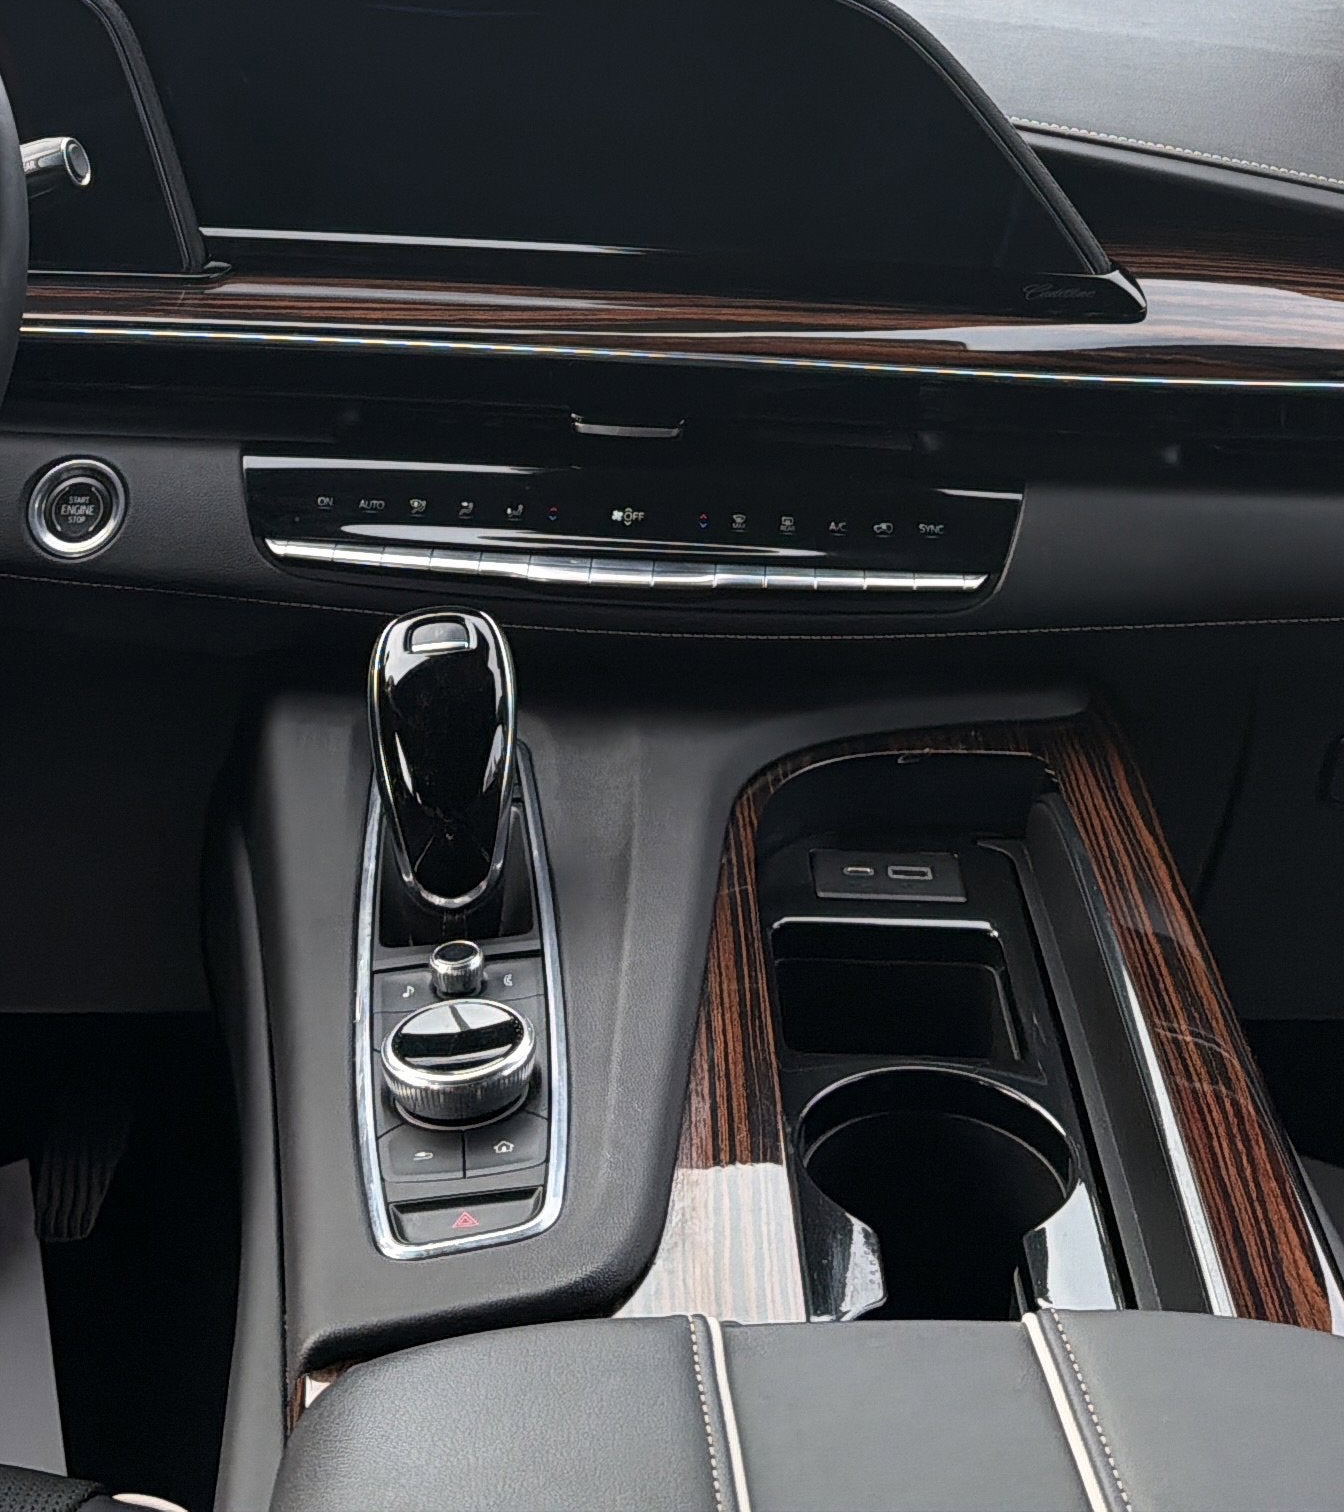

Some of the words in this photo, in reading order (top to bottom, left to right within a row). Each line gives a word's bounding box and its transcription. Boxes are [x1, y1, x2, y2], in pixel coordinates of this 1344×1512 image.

[358, 498, 386, 509] AUTO
[60, 503, 96, 516] ENGINE
[67, 515, 87, 524] STOP
[918, 523, 945, 535] SYNC
